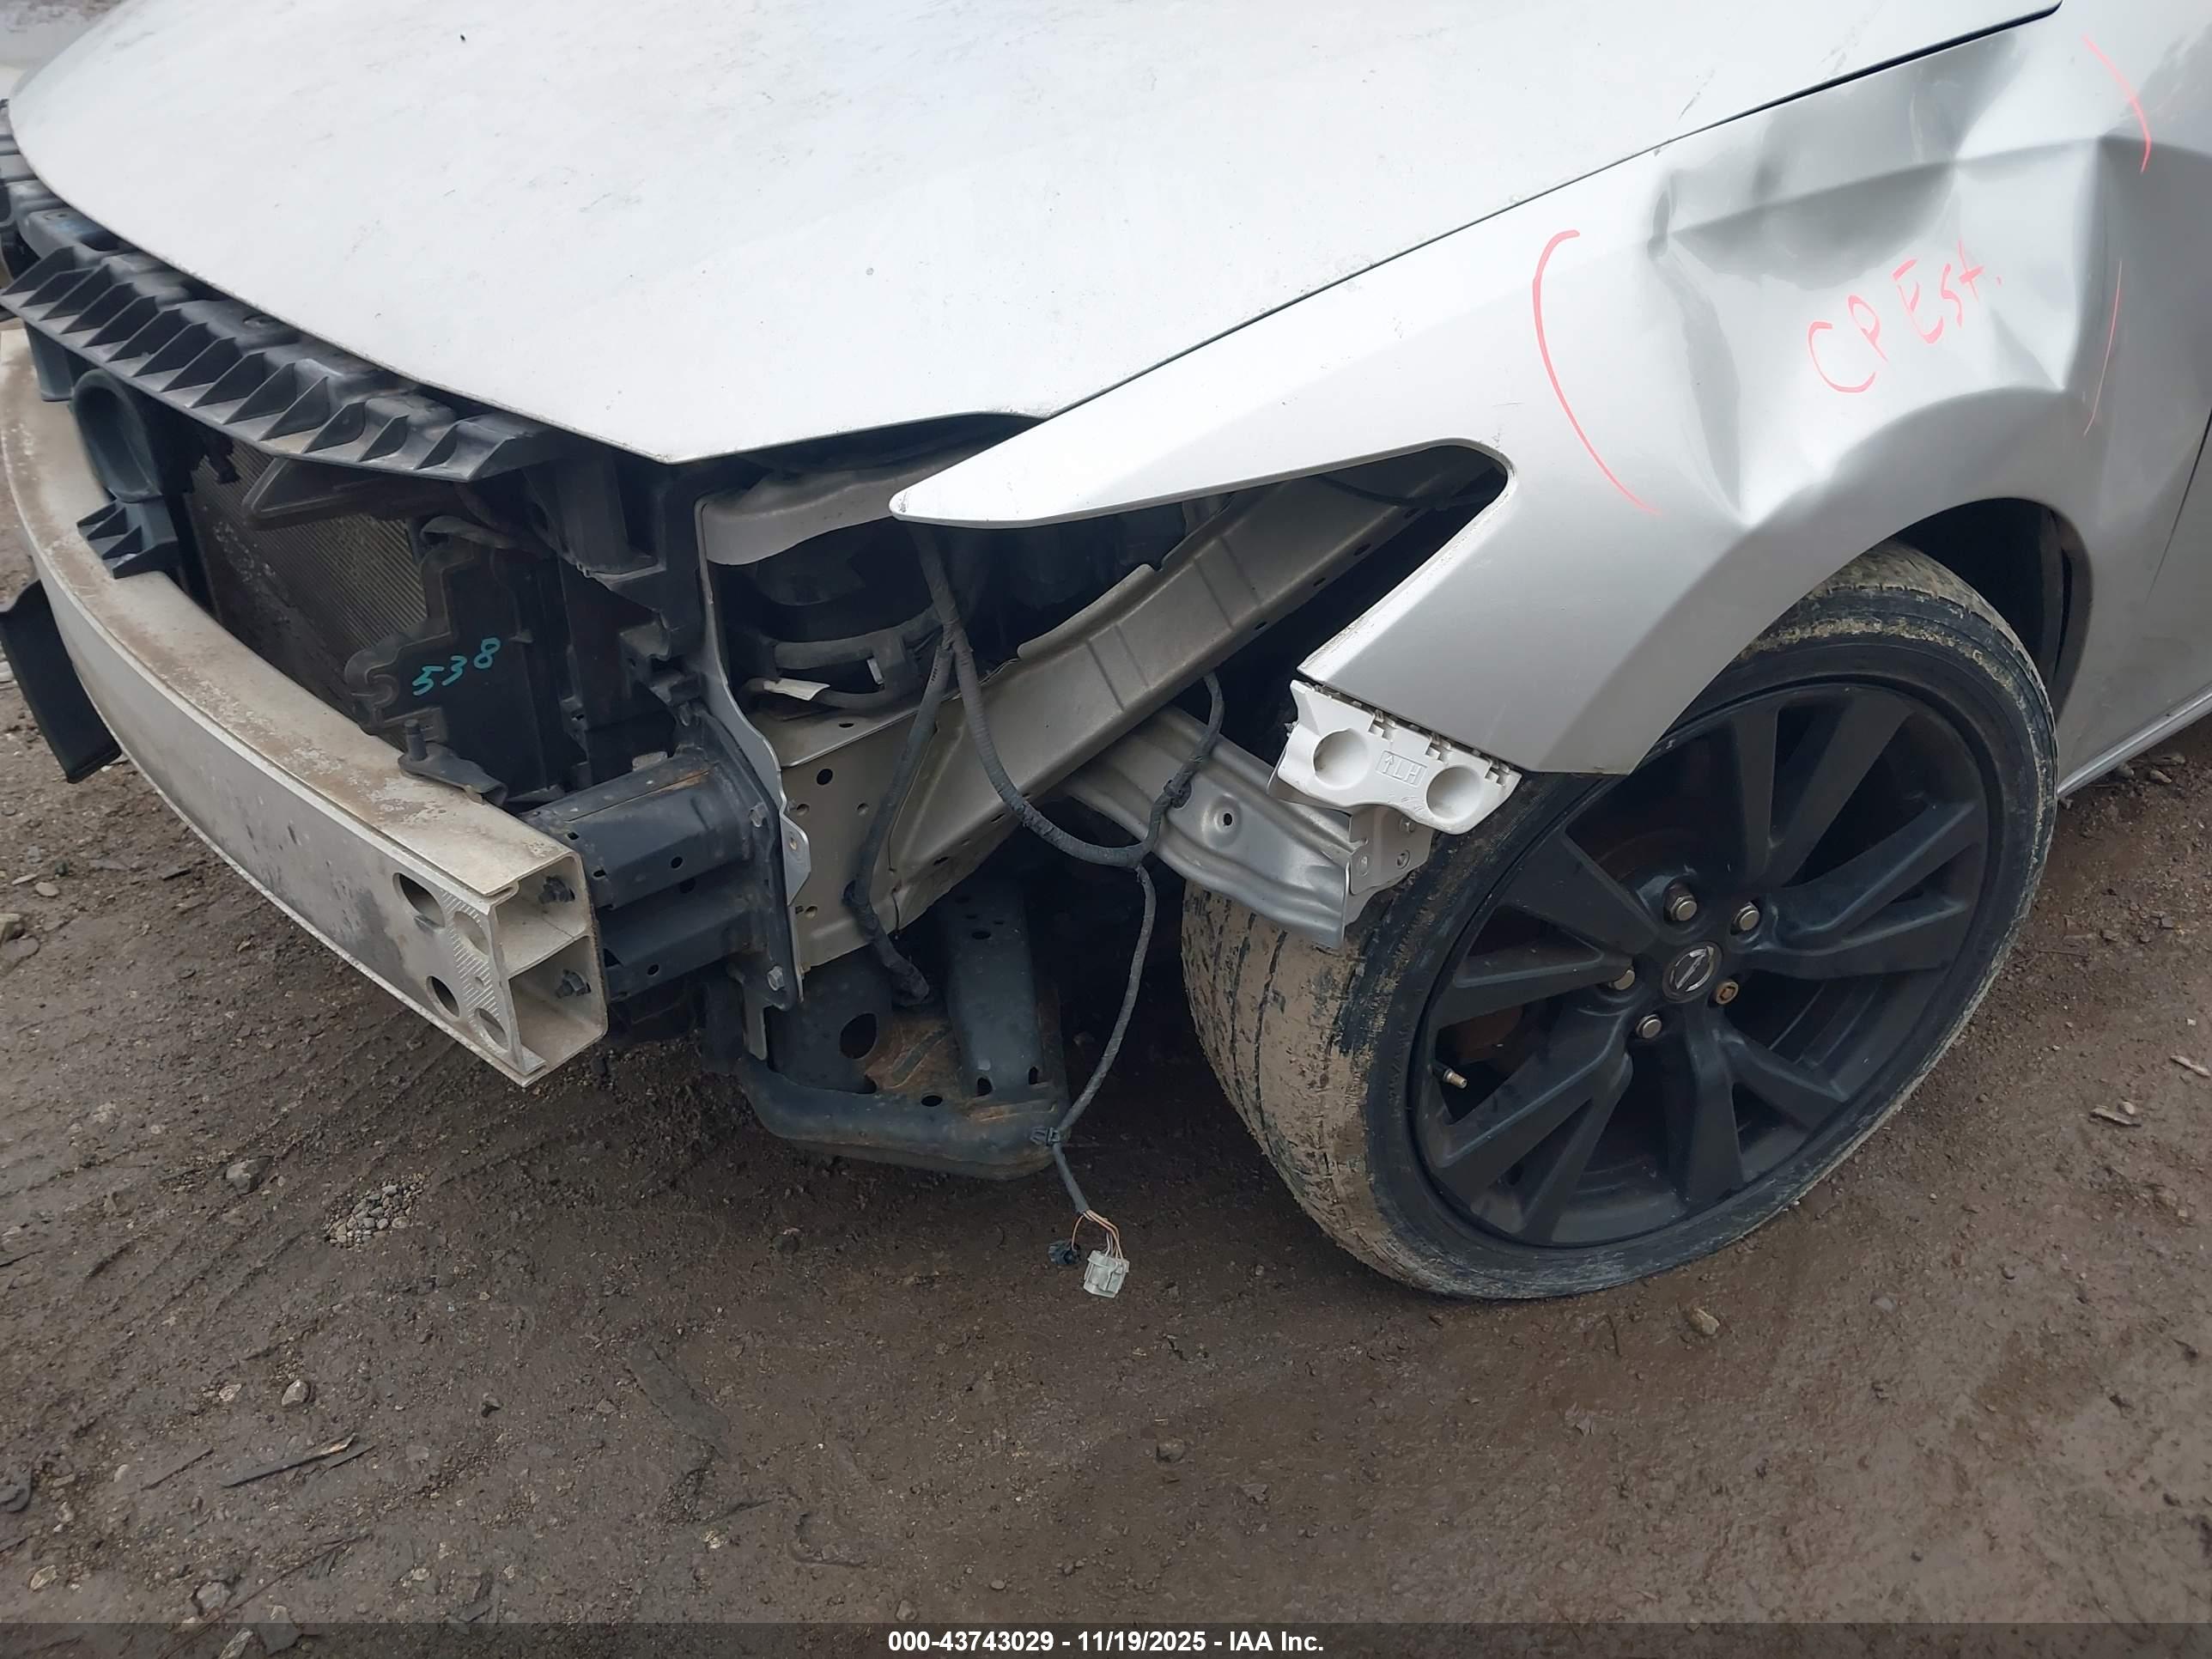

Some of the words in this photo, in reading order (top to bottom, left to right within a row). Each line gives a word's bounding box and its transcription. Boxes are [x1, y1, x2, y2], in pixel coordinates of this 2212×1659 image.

[1808, 295, 1888, 393] CP
[412, 637, 501, 696] 538
[1393, 758, 1423, 785] LH
